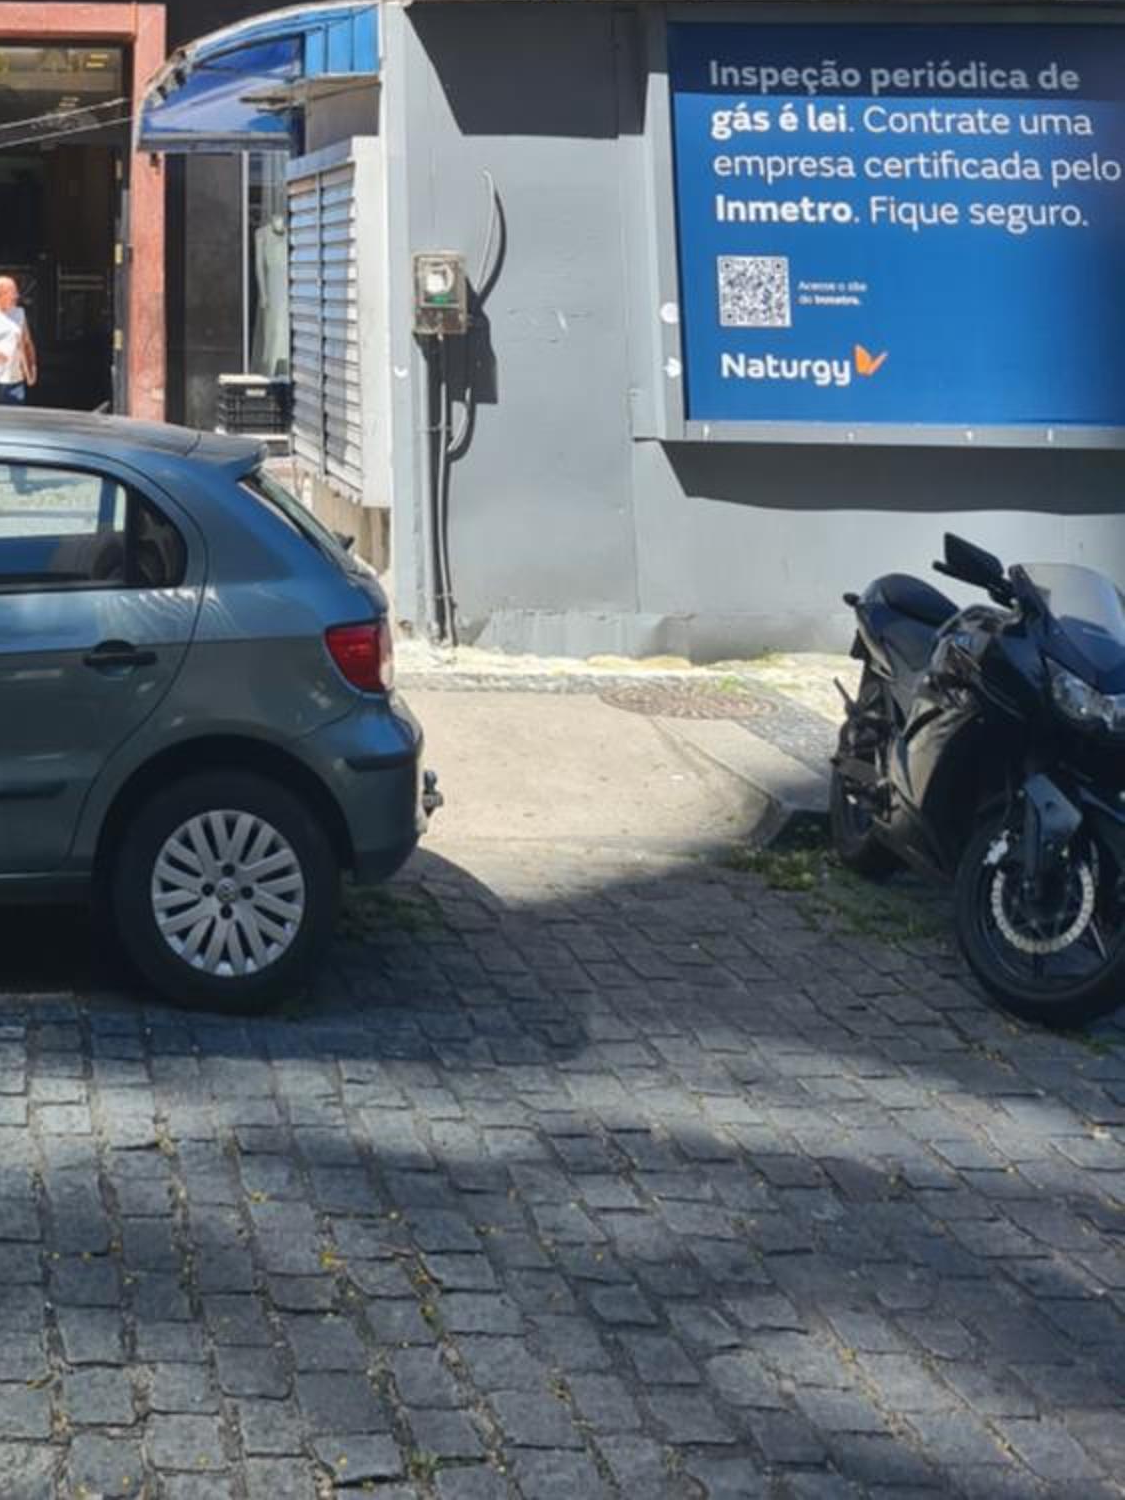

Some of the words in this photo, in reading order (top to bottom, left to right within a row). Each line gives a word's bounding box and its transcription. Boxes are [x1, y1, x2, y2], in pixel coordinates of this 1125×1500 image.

[709, 59, 862, 94] Inspeção
[870, 61, 1030, 95] periódica
[1037, 63, 1081, 91] de
[710, 102, 769, 141] gás
[779, 102, 799, 133] é
[806, 103, 854, 133] lei.
[862, 104, 1011, 135] Contrate
[1019, 113, 1094, 135] uma
[713, 155, 855, 184] empresa
[863, 151, 1042, 181] certificada
[1051, 153, 1122, 187] pelo
[715, 194, 860, 224] Inmetro.
[869, 196, 959, 231] Fique
[968, 202, 1089, 234] seguro.
[721, 353, 851, 387] Naturgy
